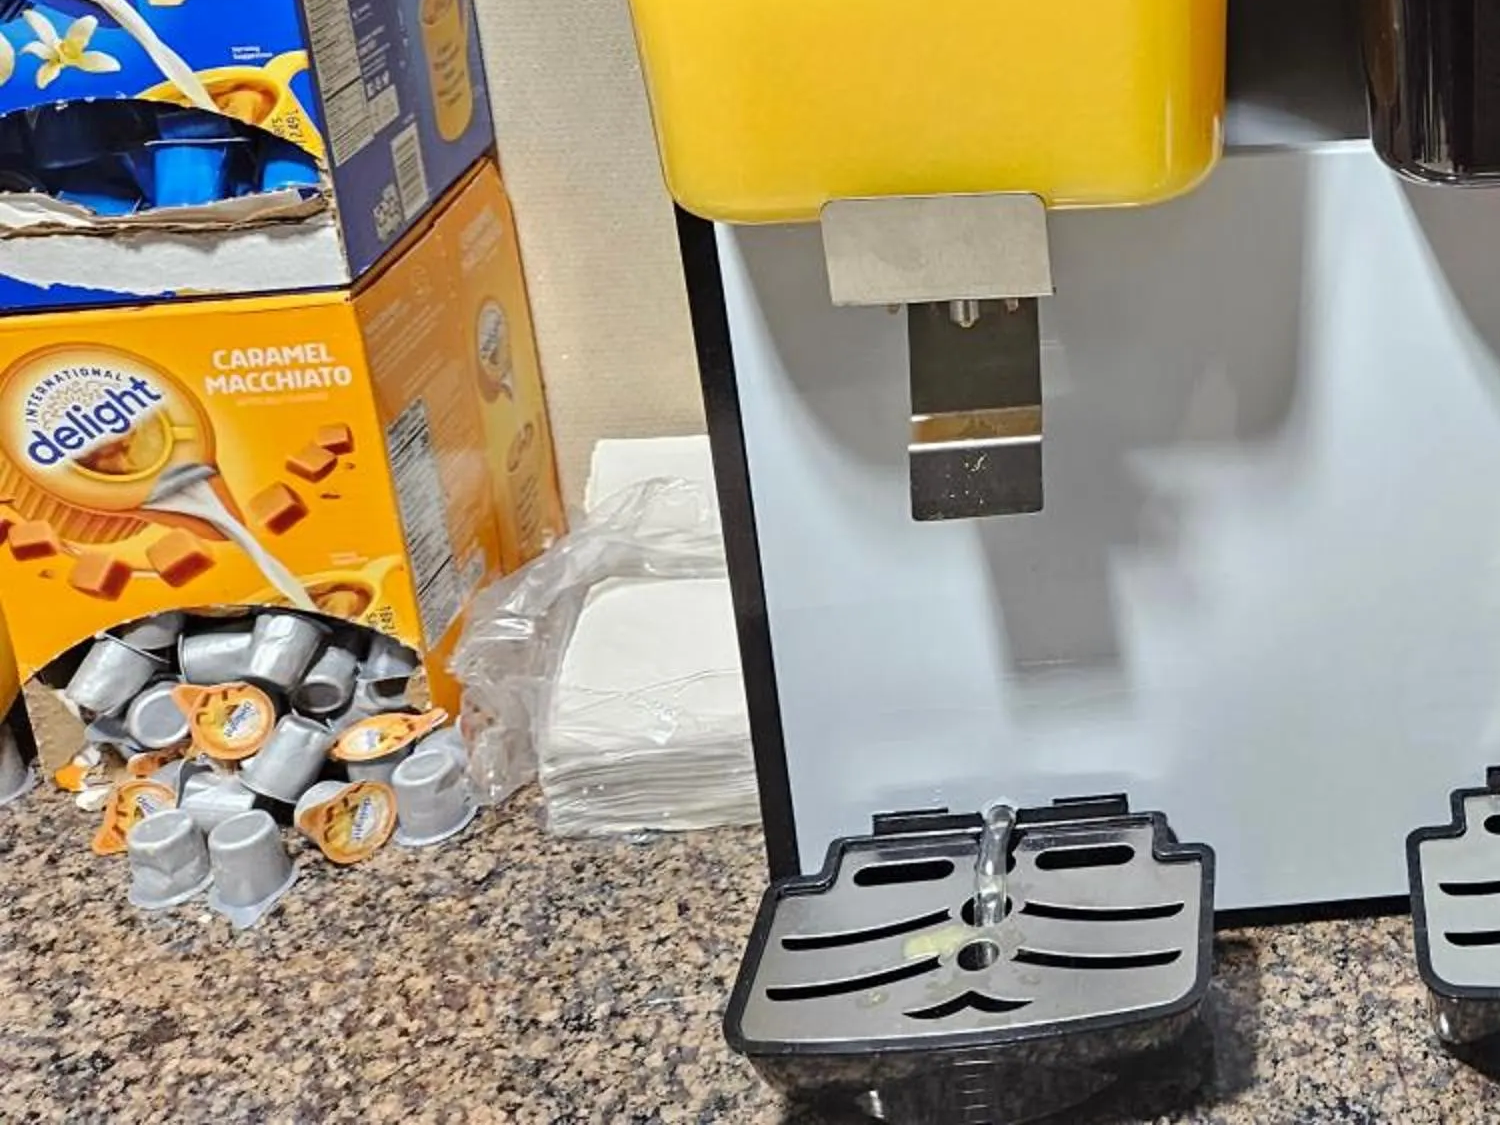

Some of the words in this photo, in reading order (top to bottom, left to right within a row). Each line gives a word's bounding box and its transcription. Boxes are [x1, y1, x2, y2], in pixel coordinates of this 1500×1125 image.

[212, 342, 336, 371] CARAMEL
[26, 367, 122, 423] INTERNATIONAL
[204, 365, 353, 396] MACCHIATO
[28, 376, 162, 465] delight
